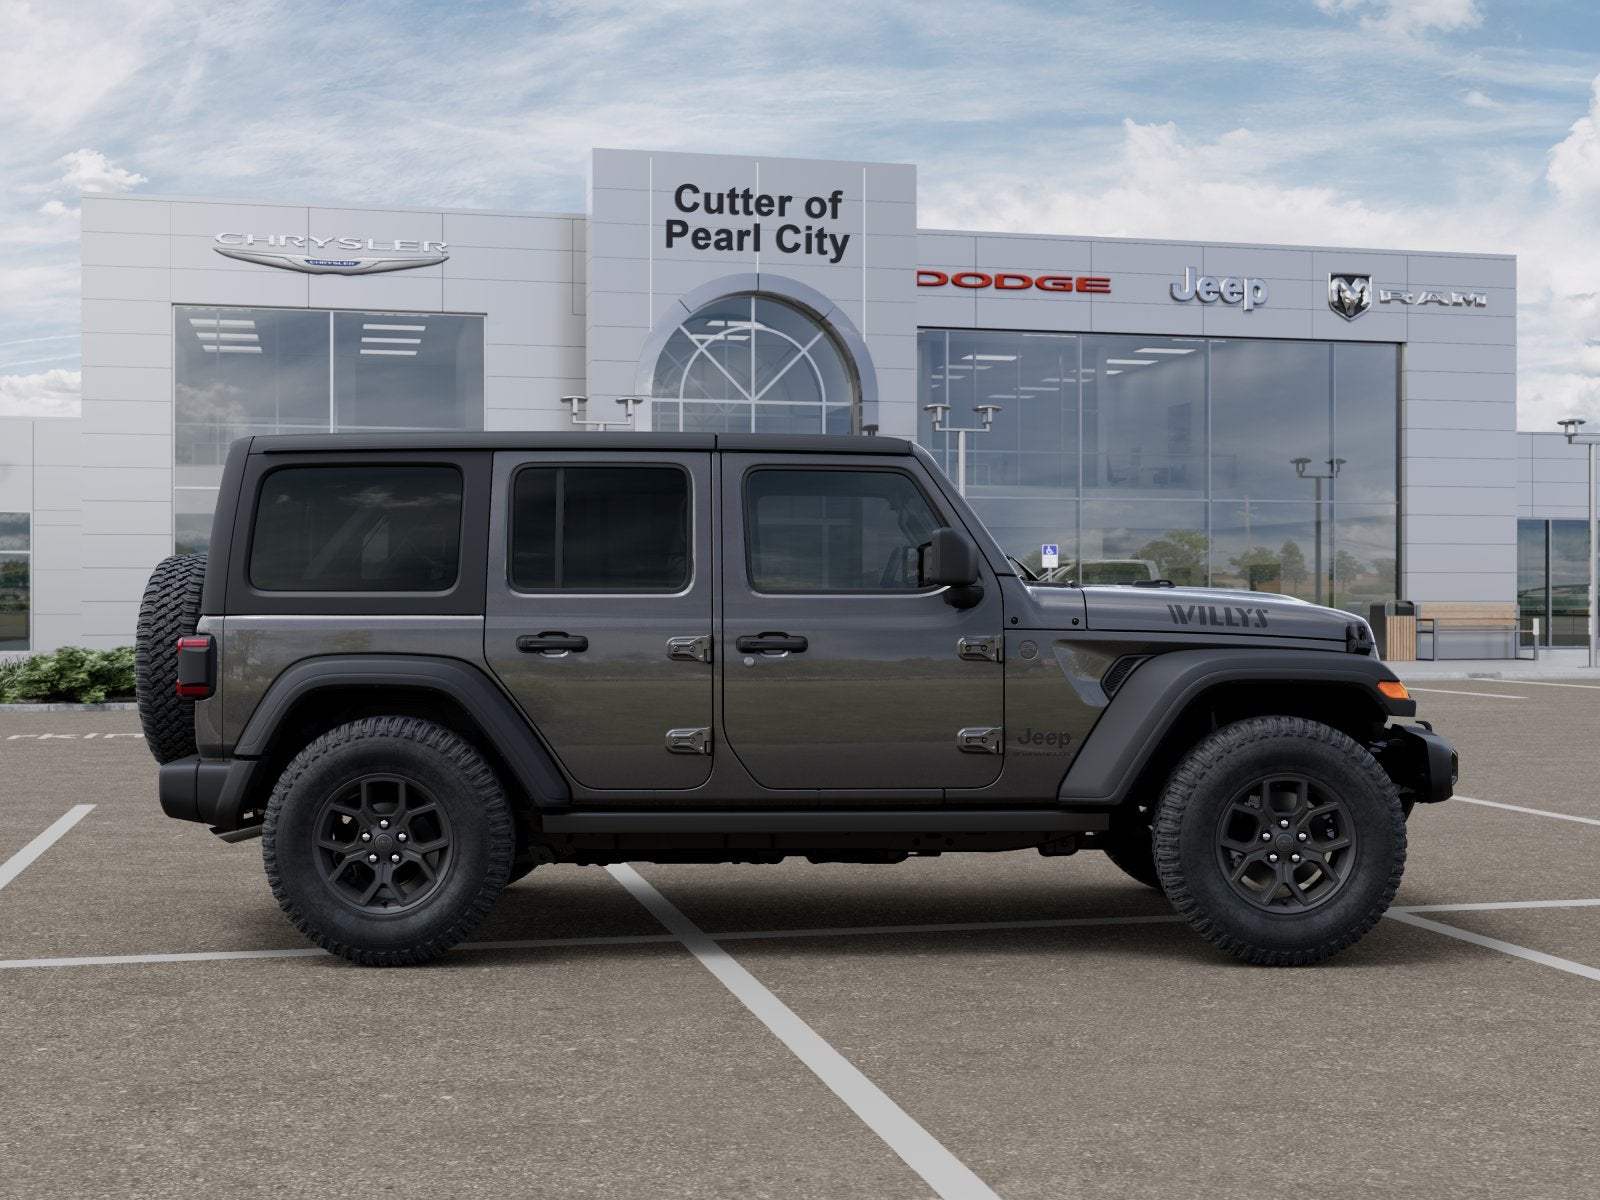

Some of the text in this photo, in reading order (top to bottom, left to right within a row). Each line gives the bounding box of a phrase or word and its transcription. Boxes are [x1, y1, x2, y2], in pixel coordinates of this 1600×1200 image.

[674, 183, 844, 219] Cutter of
[214, 232, 450, 253] CHRYSLER
[665, 219, 851, 264] Pearl City
[309, 259, 356, 267] CHRYSLER
[916, 270, 1112, 294] DODGE
[1170, 266, 1269, 311] Jeep
[1378, 288, 1488, 308] RAM
[1166, 604, 1269, 628] WILLYS
[1017, 727, 1072, 749] Jeep
